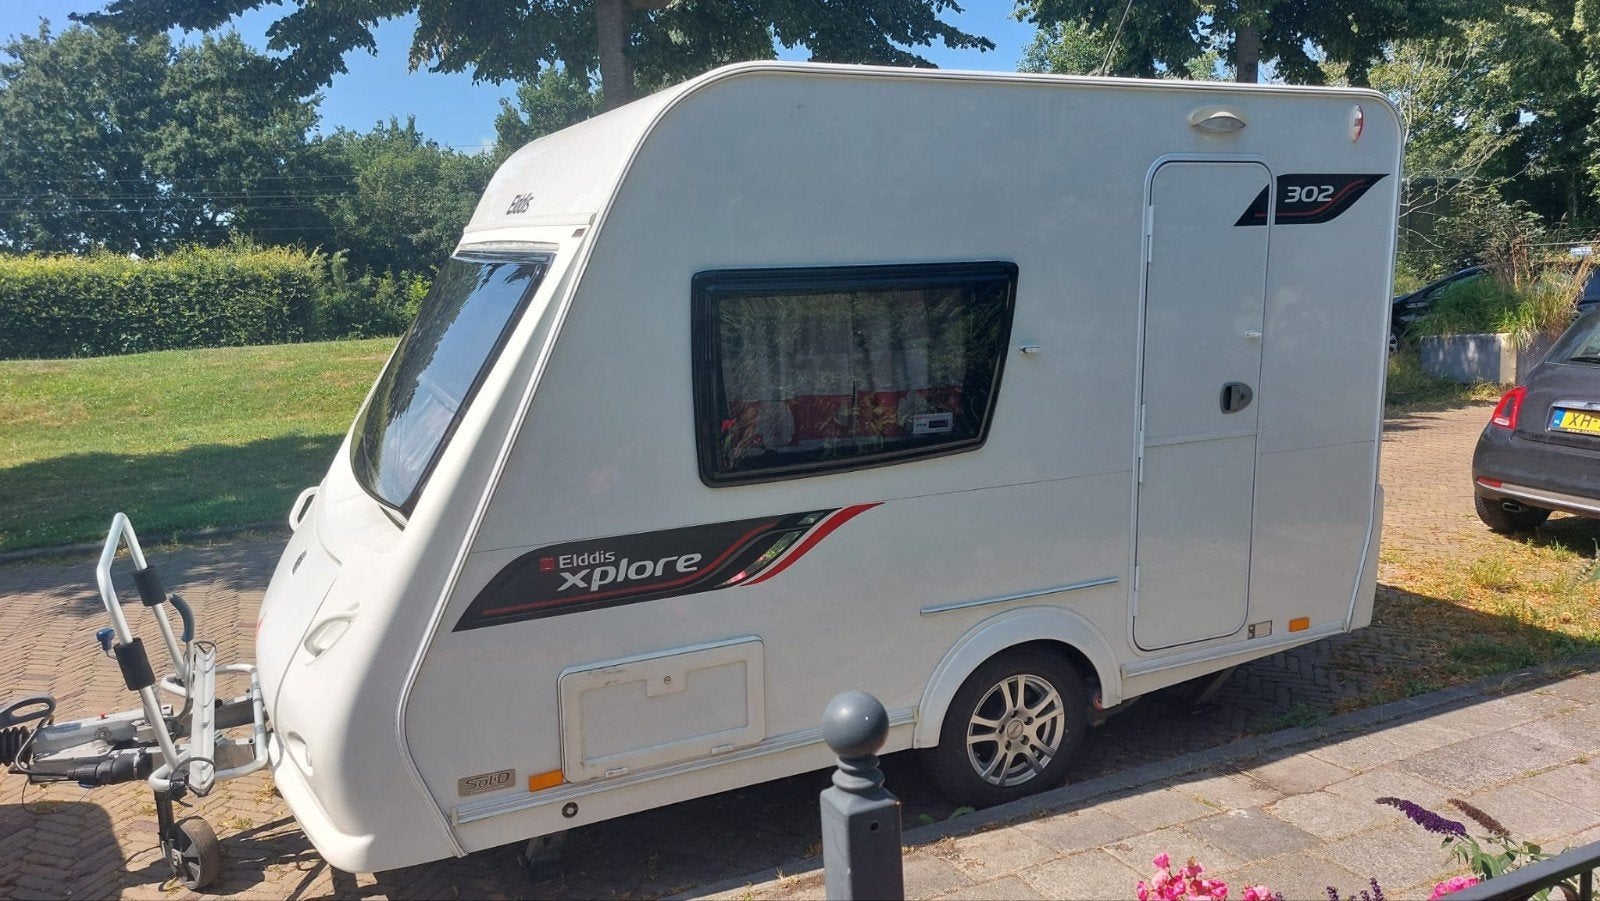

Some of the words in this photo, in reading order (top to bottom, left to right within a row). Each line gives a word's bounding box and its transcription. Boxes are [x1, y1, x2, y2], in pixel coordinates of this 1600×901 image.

[1284, 185, 1335, 203] 302
[1568, 412, 1600, 428] XH-
[559, 550, 616, 569] Elddis
[556, 553, 702, 592] xplore
